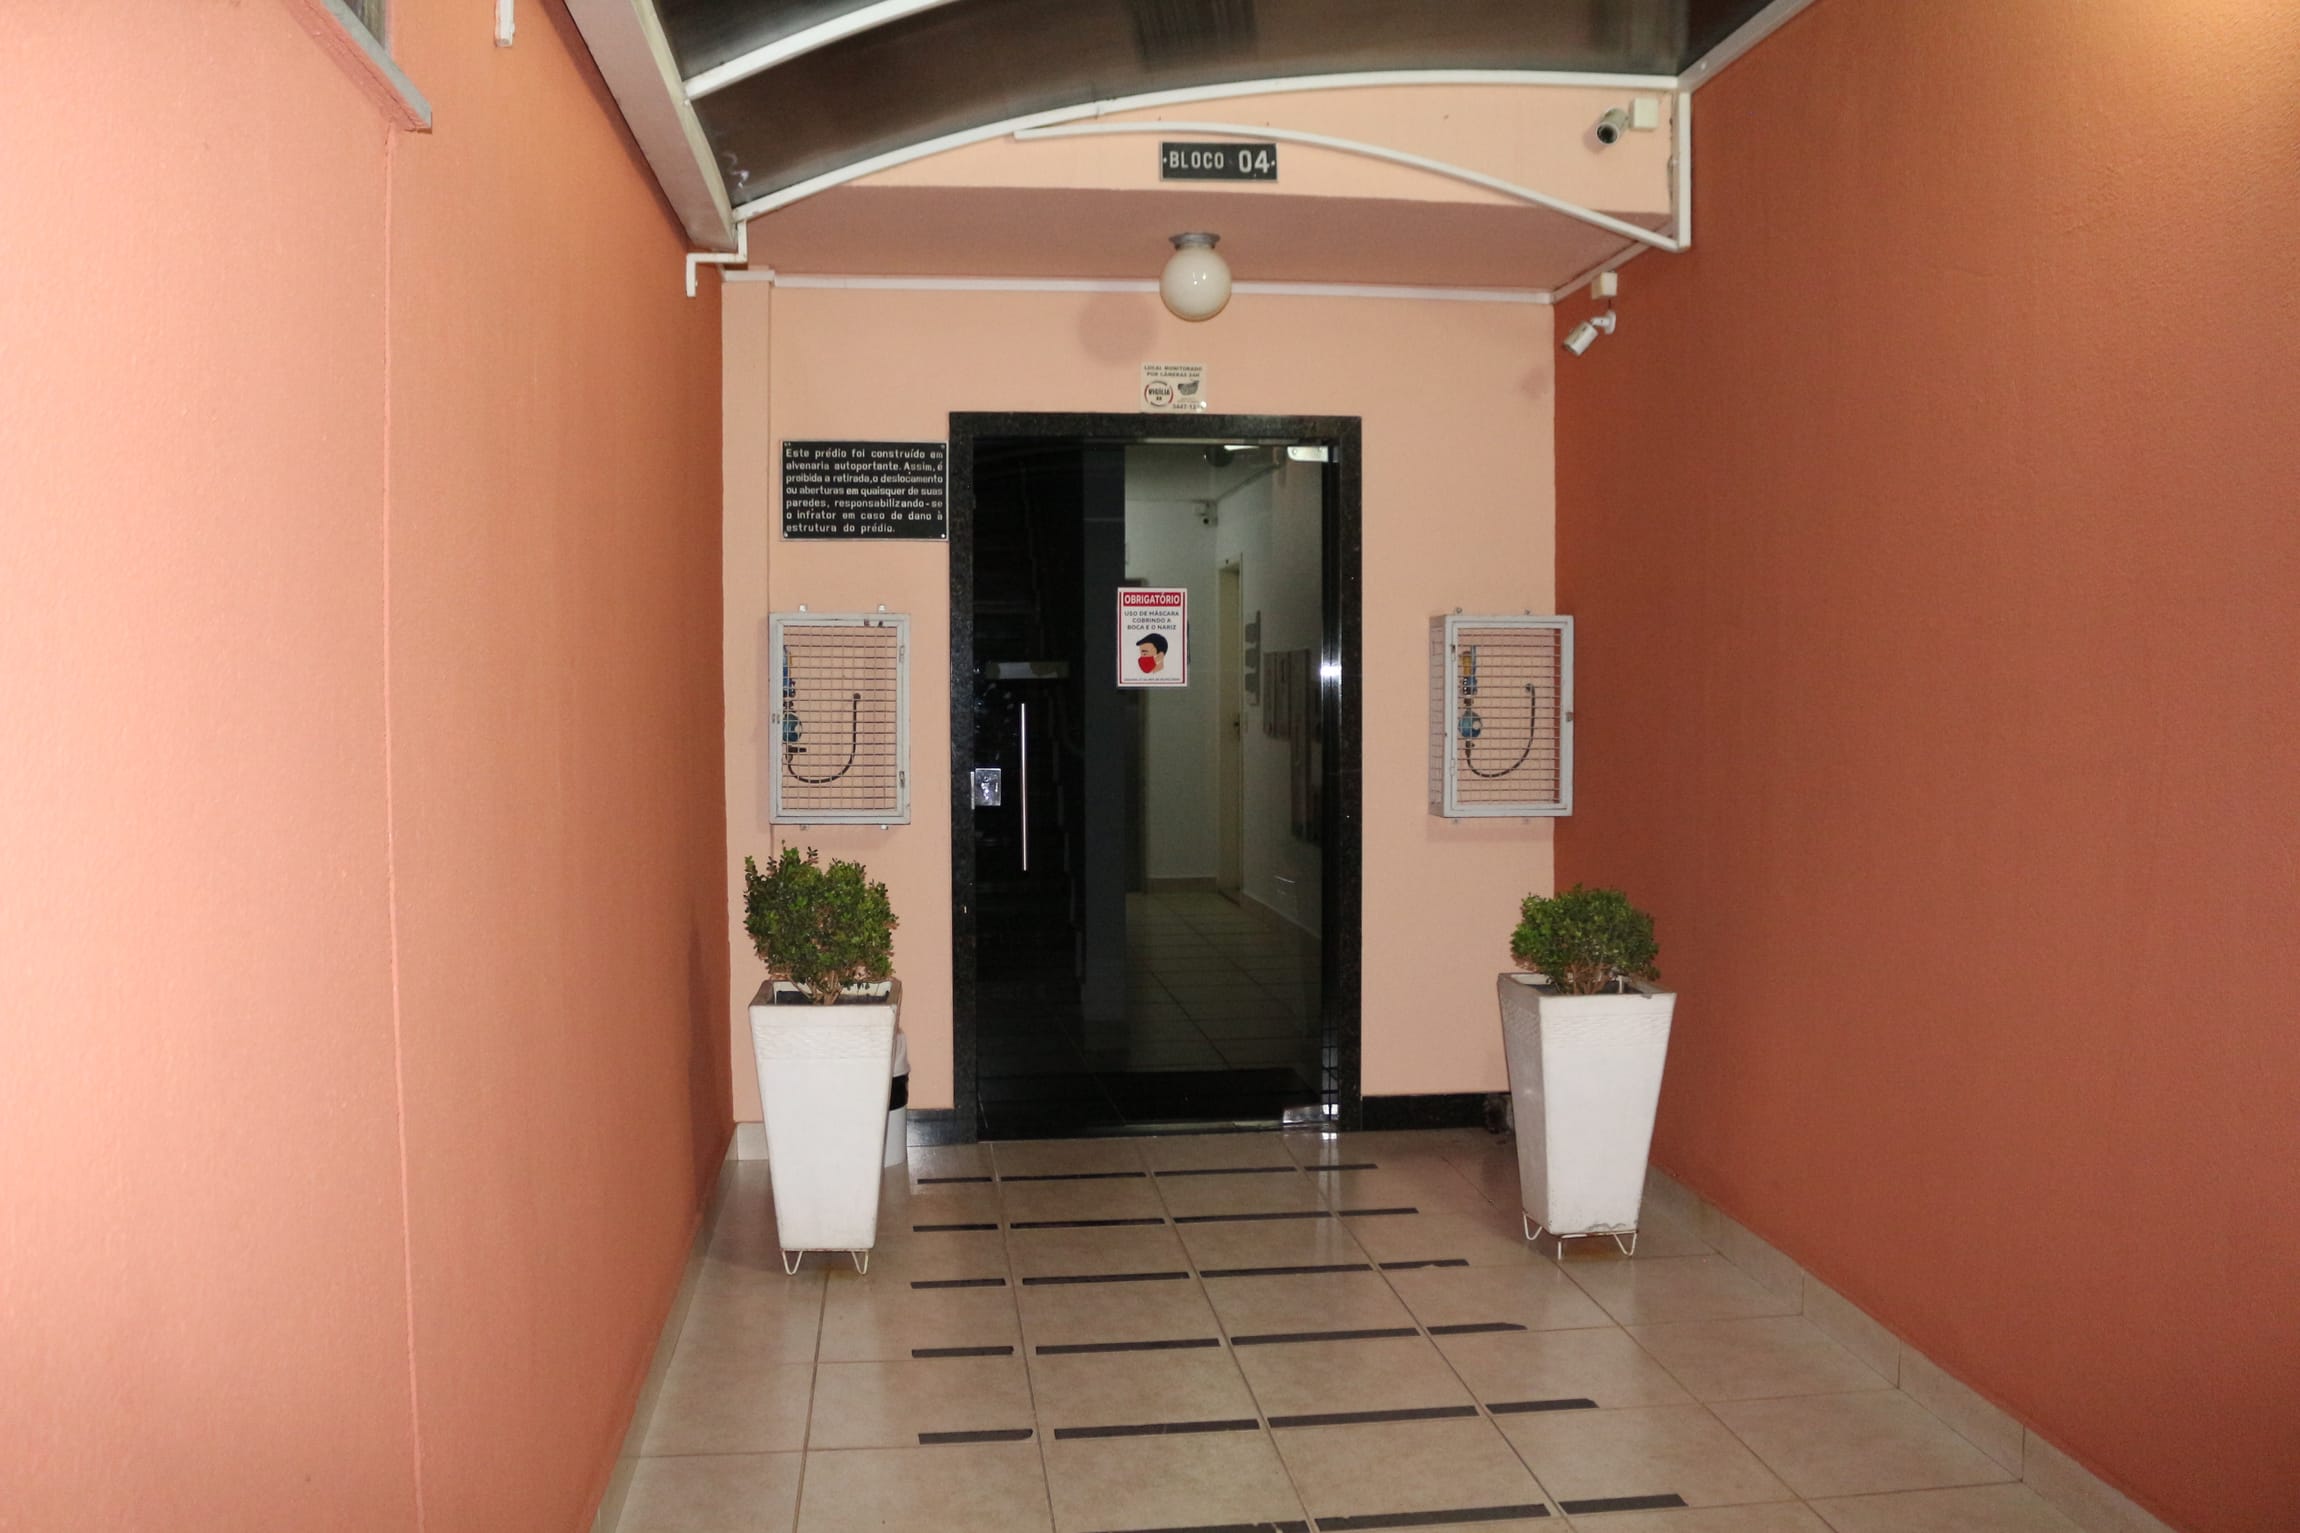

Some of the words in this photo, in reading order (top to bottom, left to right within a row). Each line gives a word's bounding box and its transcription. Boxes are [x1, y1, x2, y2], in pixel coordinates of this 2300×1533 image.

[1170, 150, 1224, 169] BLOCO
[1238, 150, 1270, 173] 04
[786, 449, 809, 458] Este
[815, 449, 847, 459] prédio
[852, 449, 865, 458] foi
[871, 449, 925, 459] construído
[786, 462, 829, 470] alvenaria
[834, 462, 901, 472] autoportante.
[903, 462, 935, 472] Assim,
[937, 462, 942, 471] é
[786, 474, 822, 485] proibida
[880, 474, 943, 483] deslocamento
[799, 486, 844, 494] aberturas
[861, 486, 905, 497] quaisquer
[908, 487, 918, 495] de
[786, 499, 830, 509] paredes,
[797, 511, 836, 520] infrator
[891, 512, 902, 520] de
[908, 512, 932, 520] dano
[937, 511, 943, 521] à
[786, 524, 837, 532] estrutura
[843, 524, 855, 532] do
[861, 523, 895, 534] prédio.
[1124, 592, 1180, 604] OBRIGATÓRIO
